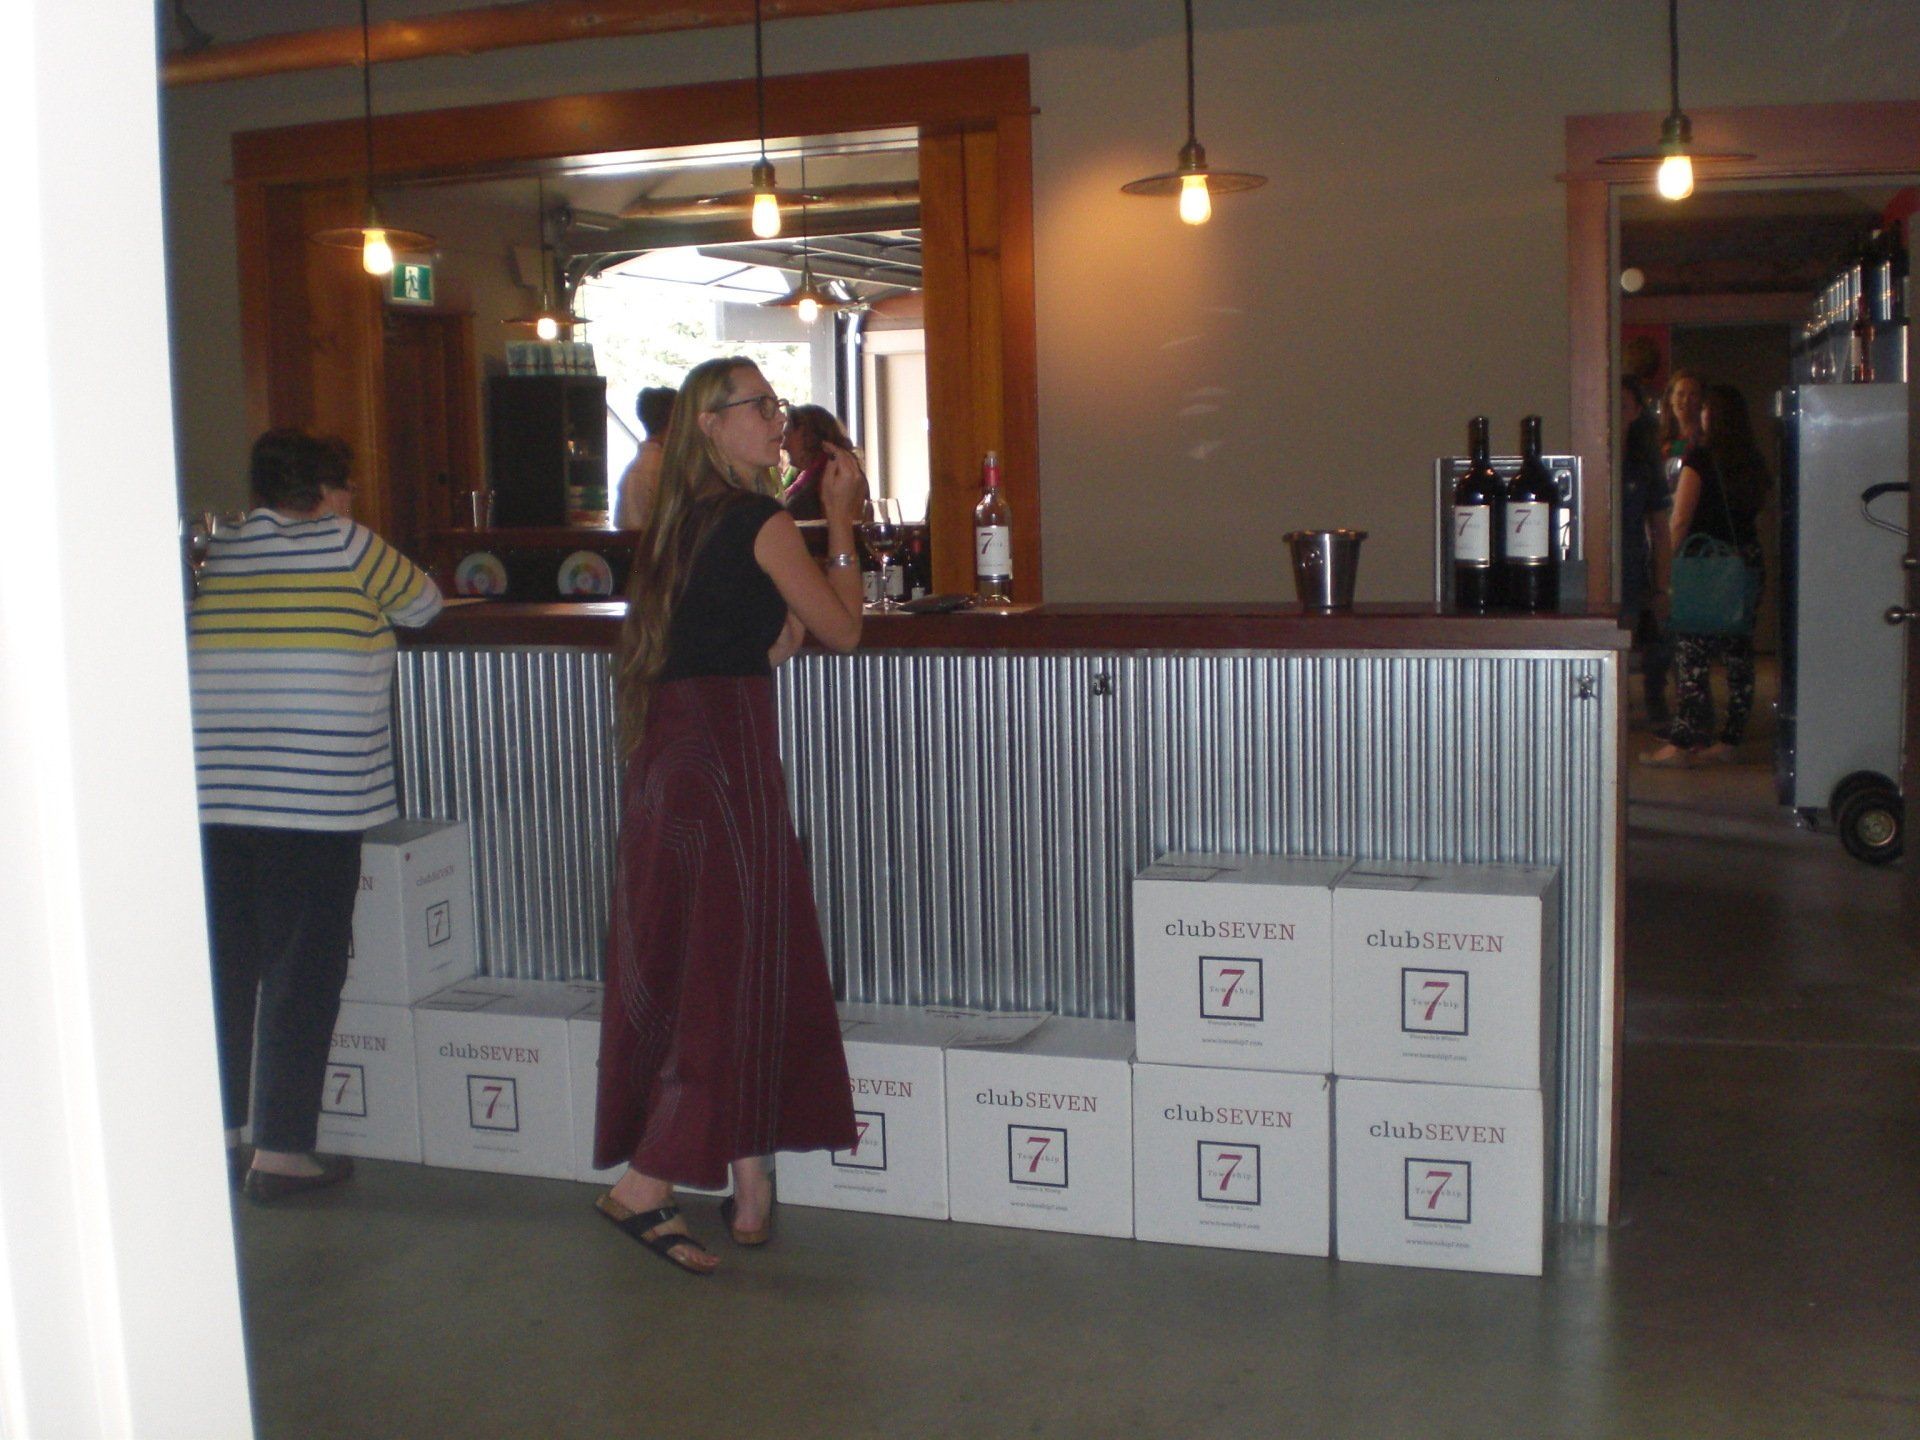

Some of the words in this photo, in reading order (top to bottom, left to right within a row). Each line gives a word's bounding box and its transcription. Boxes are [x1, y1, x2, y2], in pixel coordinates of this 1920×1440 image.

[1458, 511, 1474, 536] 7
[1515, 509, 1532, 533] 7
[981, 532, 994, 554] 7
[434, 910, 443, 937] 7
[1165, 919, 1296, 940] clubSEVEN
[1366, 930, 1504, 952] clubSEVEN
[1209, 985, 1255, 995] Towship
[1219, 969, 1246, 1007] 7
[1411, 998, 1459, 1009] Towhip
[1423, 981, 1450, 1021] 7
[439, 1042, 539, 1064] clubSEVEN
[332, 1072, 351, 1104] 7
[976, 1088, 1098, 1112] clubSEVEN
[482, 1086, 502, 1119] 7
[1164, 1104, 1293, 1128] clubSEVEN
[851, 1121, 870, 1156] 7
[1369, 1120, 1506, 1144] clubSEVEN
[1017, 1152, 1059, 1163] Towhip
[1027, 1136, 1051, 1173] 7
[1207, 1170, 1252, 1181] Towhip
[1217, 1153, 1243, 1191] 7
[1414, 1187, 1462, 1198] Towhip
[1426, 1170, 1453, 1210] 7
